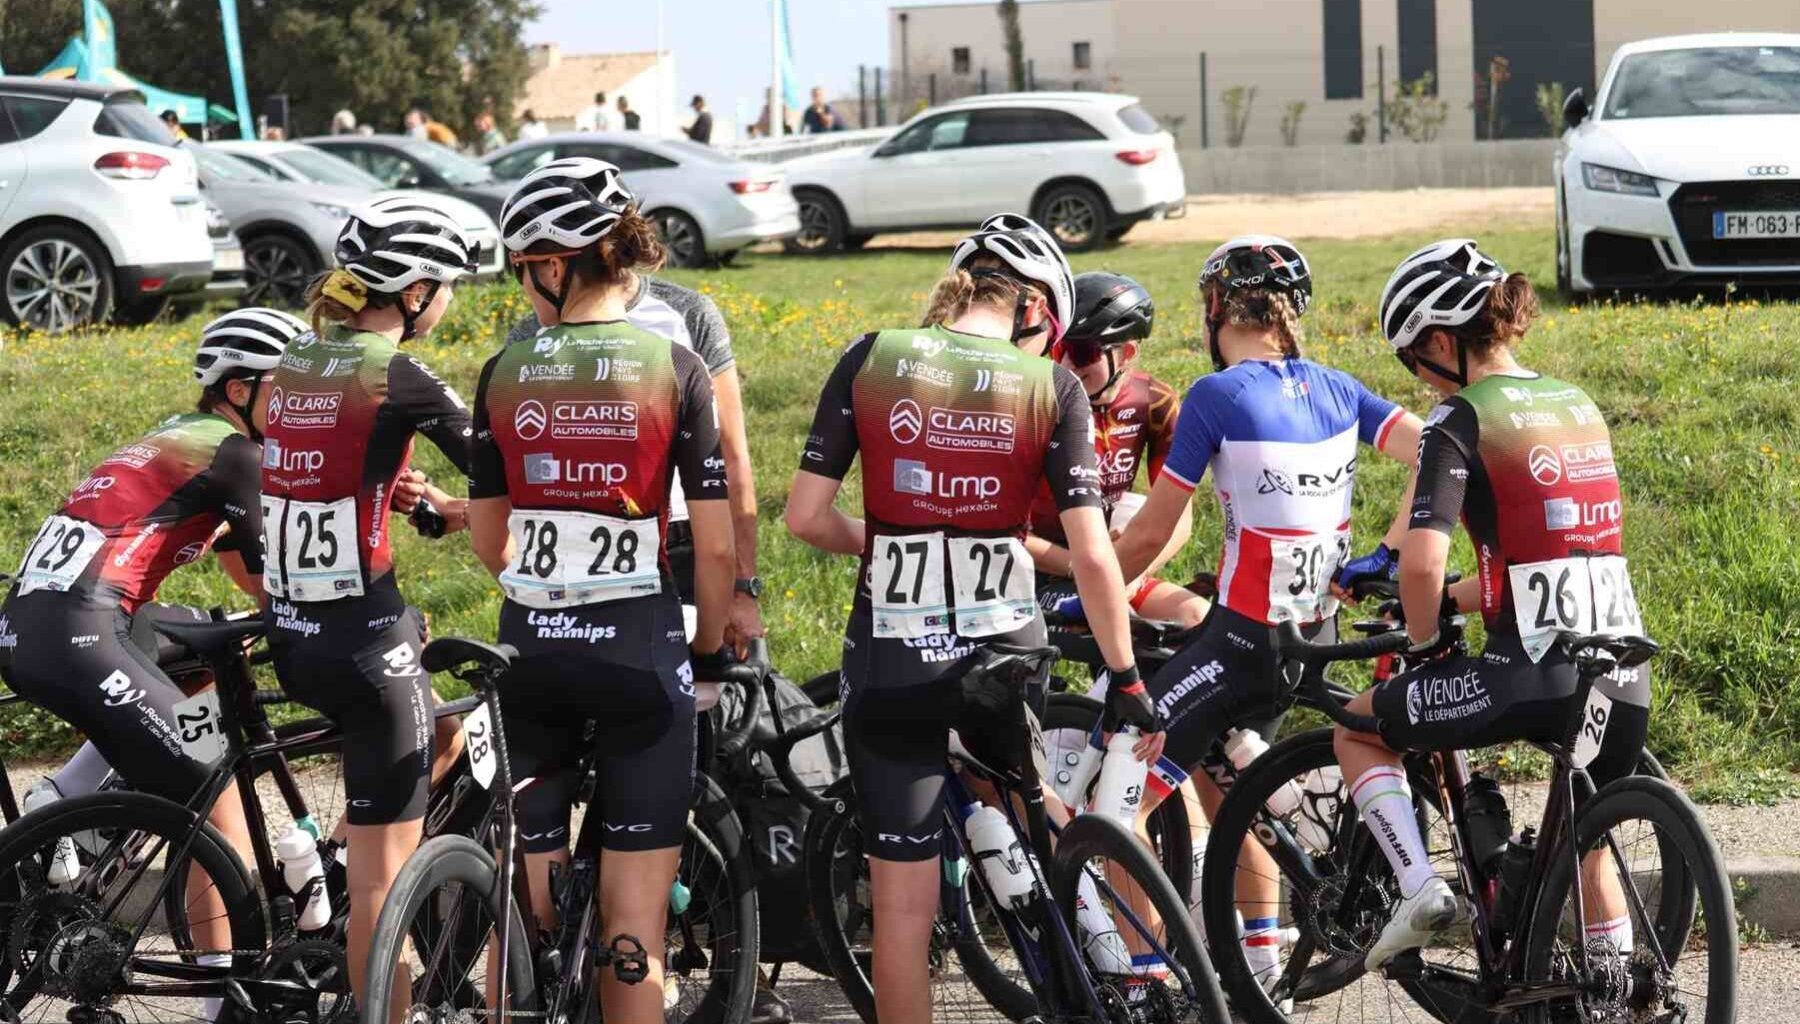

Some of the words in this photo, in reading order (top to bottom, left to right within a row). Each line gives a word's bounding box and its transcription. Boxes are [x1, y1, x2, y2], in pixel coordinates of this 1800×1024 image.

[531, 363, 575, 375] VENDÉE
[909, 361, 954, 383] VENDÉE
[287, 396, 338, 411] CLARIS
[555, 405, 636, 421] CLARIS
[283, 416, 335, 425] AUTOMOBILES
[554, 427, 636, 437] AUTOMOBILES
[930, 412, 1013, 435] CLARIS
[928, 435, 1012, 450] AUTOMOBILES
[543, 488, 581, 499] GROUPE
[369, 482, 385, 548] dynamips
[912, 499, 953, 518] GROUPE
[36, 524, 85, 573] 29
[297, 510, 338, 569] 25
[517, 520, 558, 578] 28
[588, 526, 639, 576] 28
[886, 541, 928, 605] 27
[969, 543, 1015, 602] 27
[1288, 544, 1324, 596] 30
[1528, 567, 1579, 629] 26
[276, 615, 321, 637] namips
[368, 615, 398, 628] DIFFU
[537, 623, 617, 643] namips
[72, 635, 100, 644] DIFFU
[1227, 632, 1255, 650] DIFFU
[1156, 660, 1225, 720] ynamips
[1424, 668, 1486, 706] VENDÉE
[1434, 694, 1492, 721] DÉPARTEMENT
[177, 706, 213, 743] 25
[1584, 704, 1606, 745] 26
[468, 721, 488, 765] 28
[769, 825, 797, 864] R
